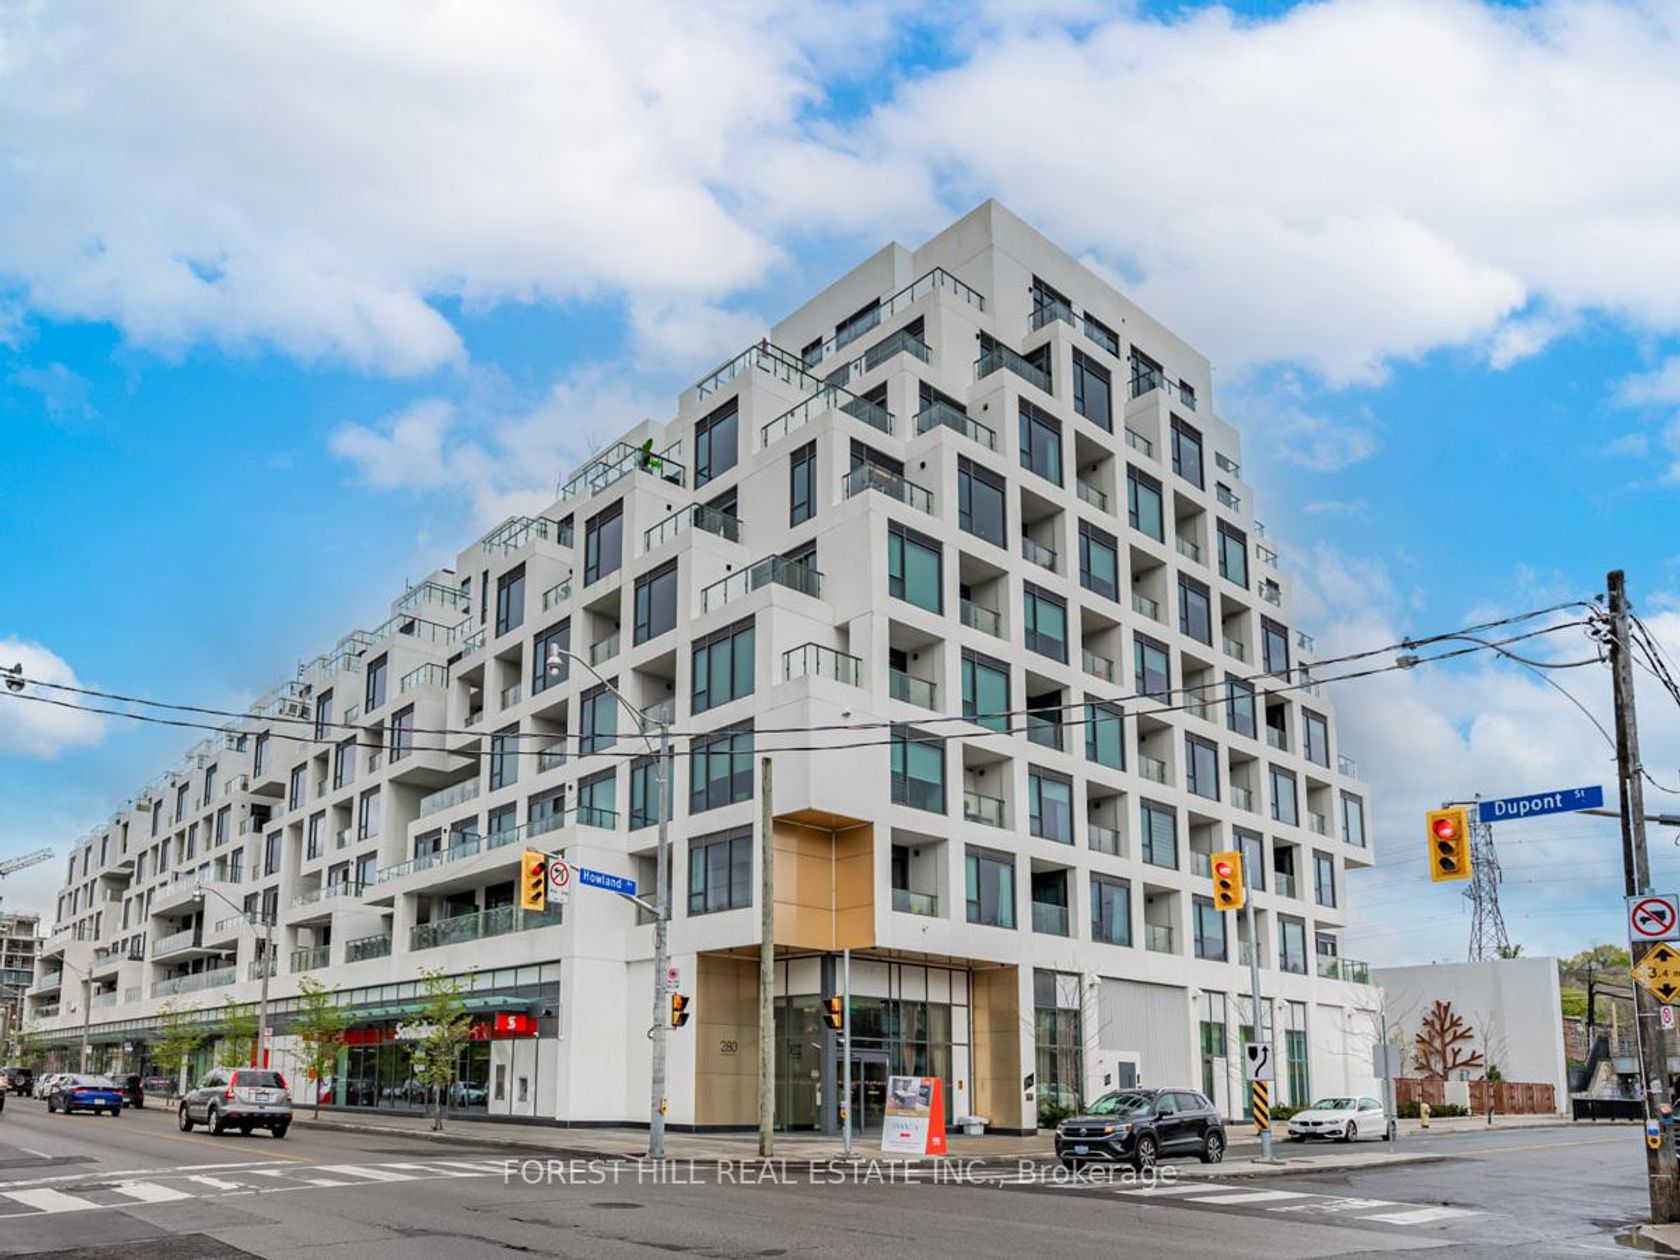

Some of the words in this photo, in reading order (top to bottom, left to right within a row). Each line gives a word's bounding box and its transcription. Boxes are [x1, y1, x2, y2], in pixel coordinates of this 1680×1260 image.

[1494, 793, 1563, 816] Dupont
[1574, 789, 1585, 799] St
[583, 870, 622, 889] Howland
